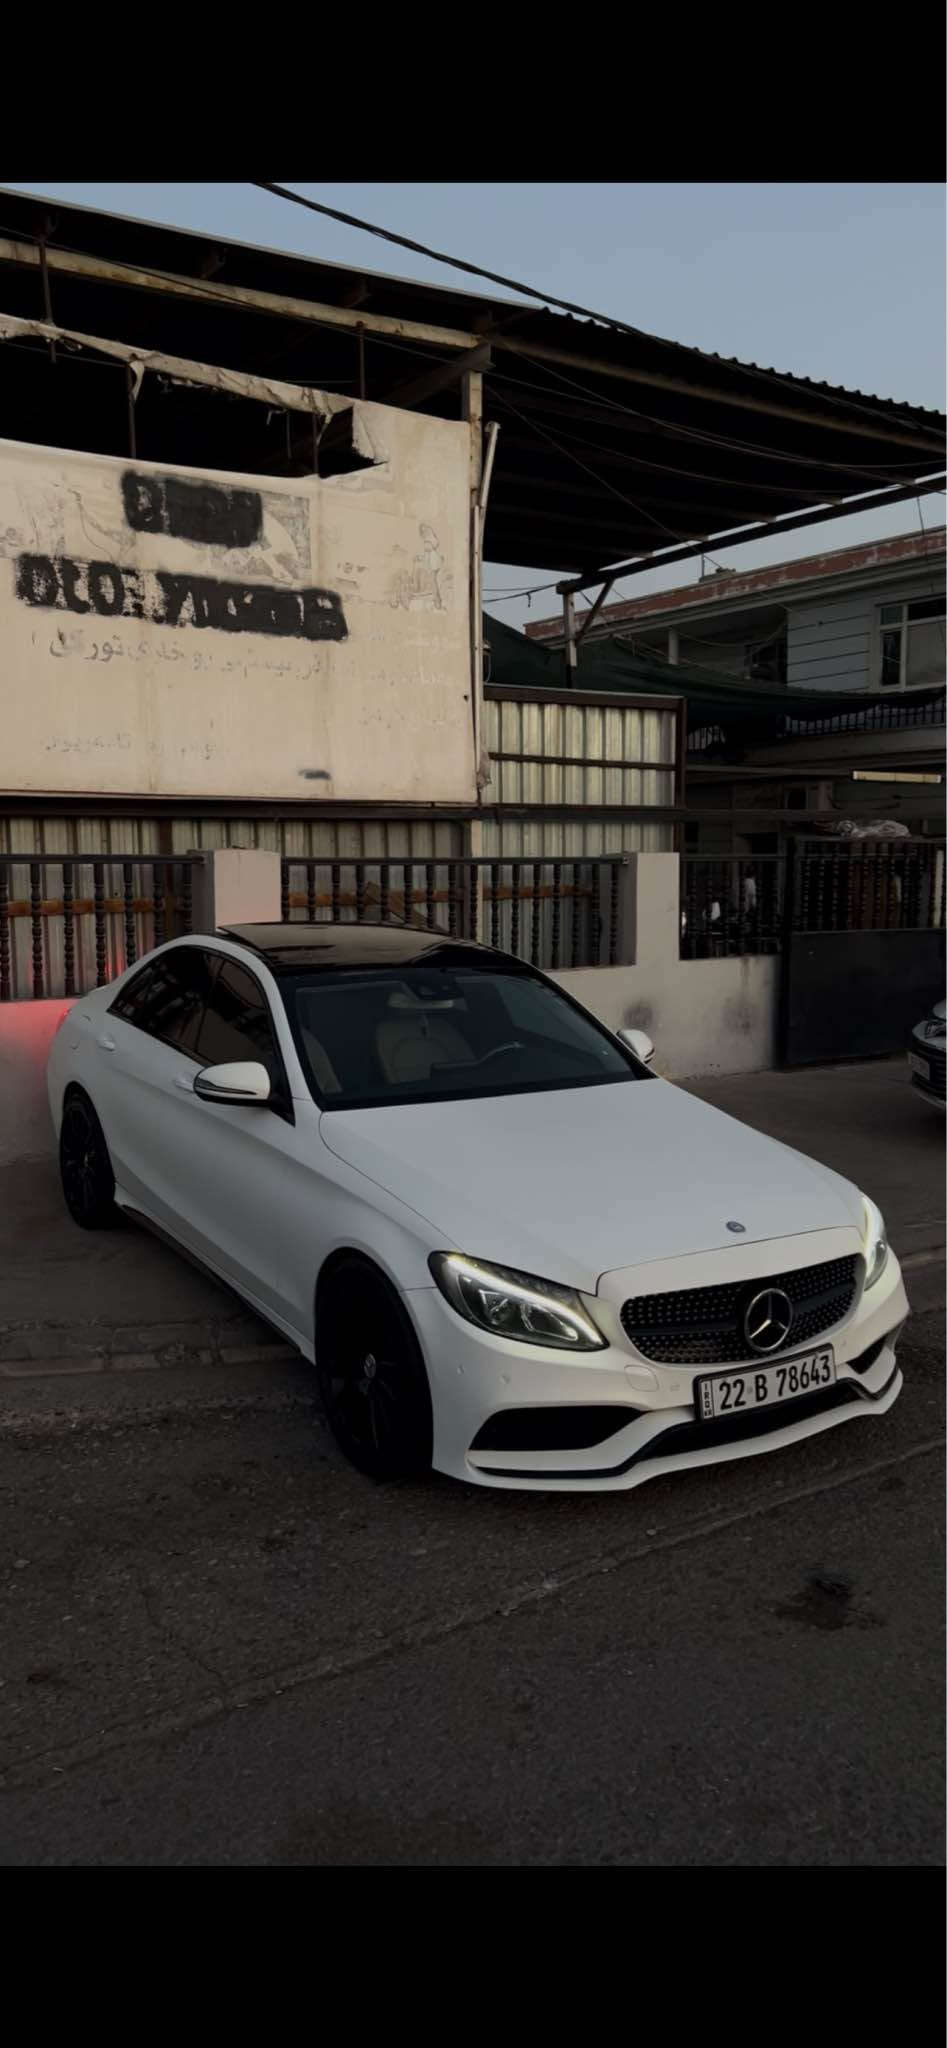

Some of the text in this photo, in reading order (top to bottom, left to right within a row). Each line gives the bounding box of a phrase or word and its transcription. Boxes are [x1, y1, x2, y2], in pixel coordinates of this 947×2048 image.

[719, 1354, 831, 1410] 22 B 78643
